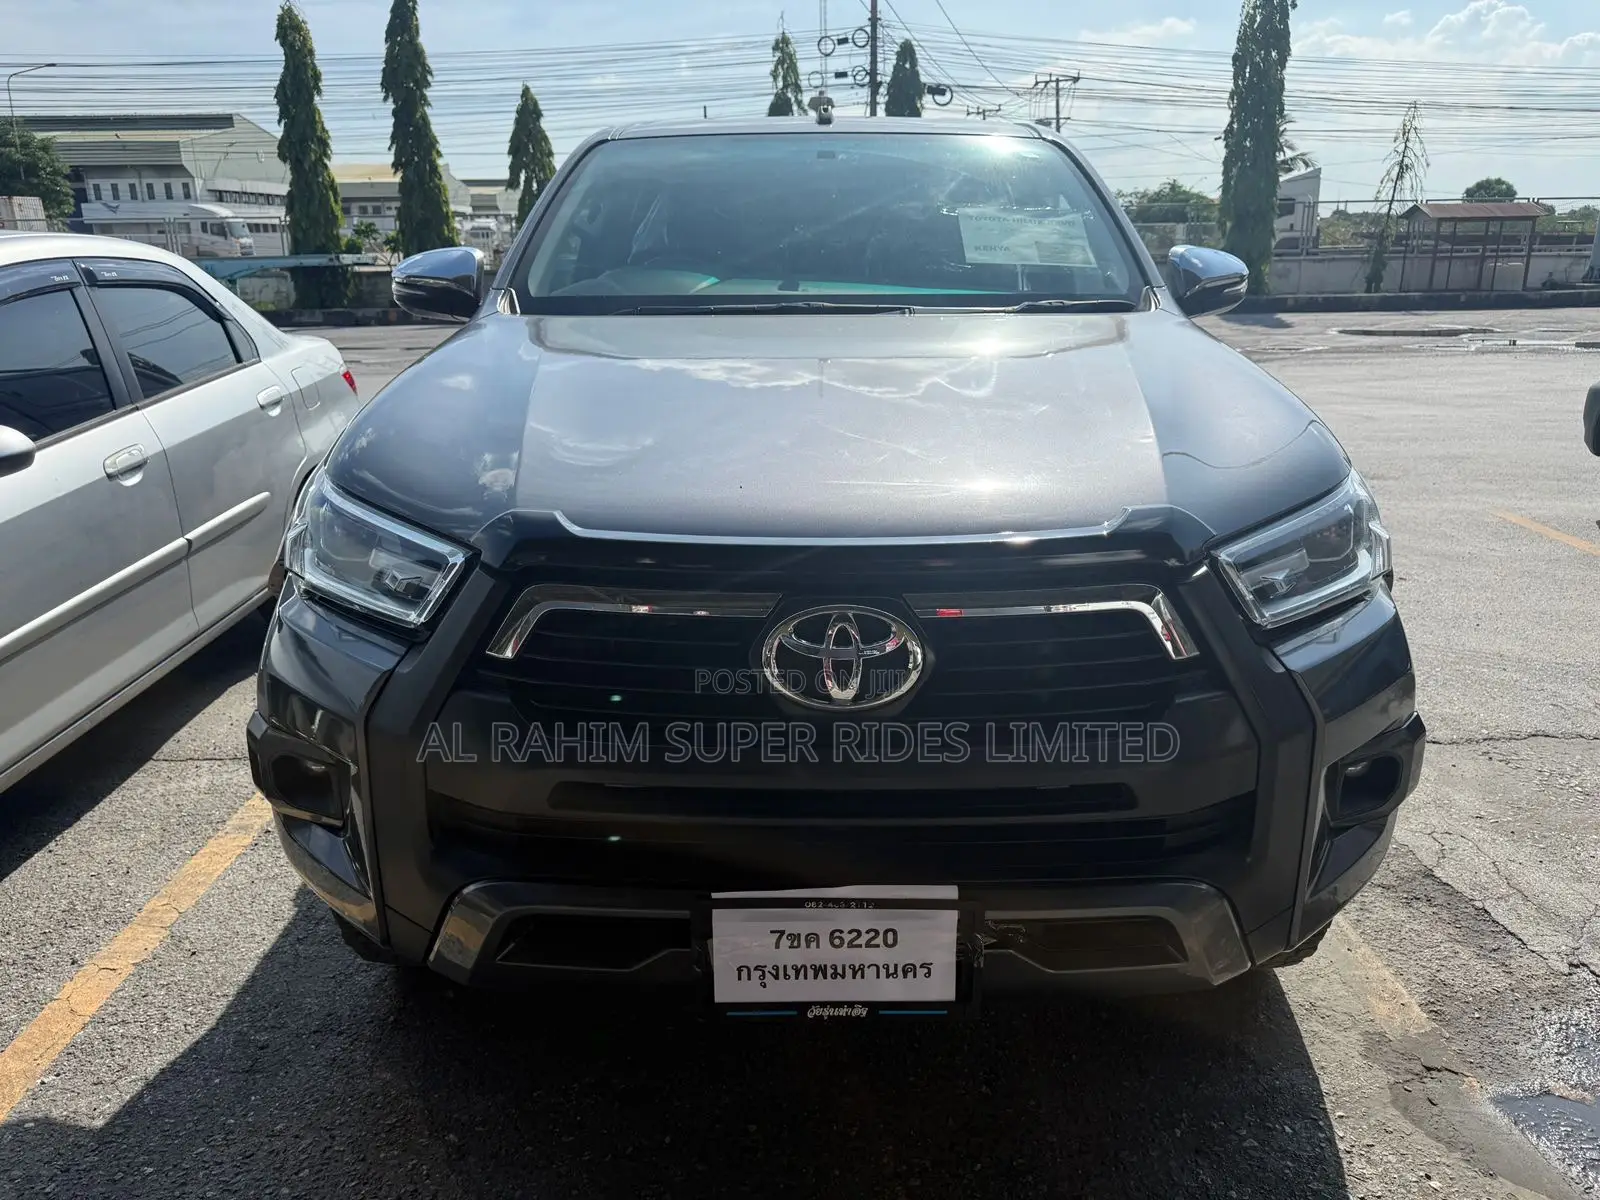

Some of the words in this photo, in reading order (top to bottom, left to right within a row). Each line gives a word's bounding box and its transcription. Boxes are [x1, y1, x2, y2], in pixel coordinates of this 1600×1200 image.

[769, 930, 821, 949] 7ขค
[828, 928, 899, 949] 6220
[736, 961, 934, 988] กรุงเทพมหานคร
